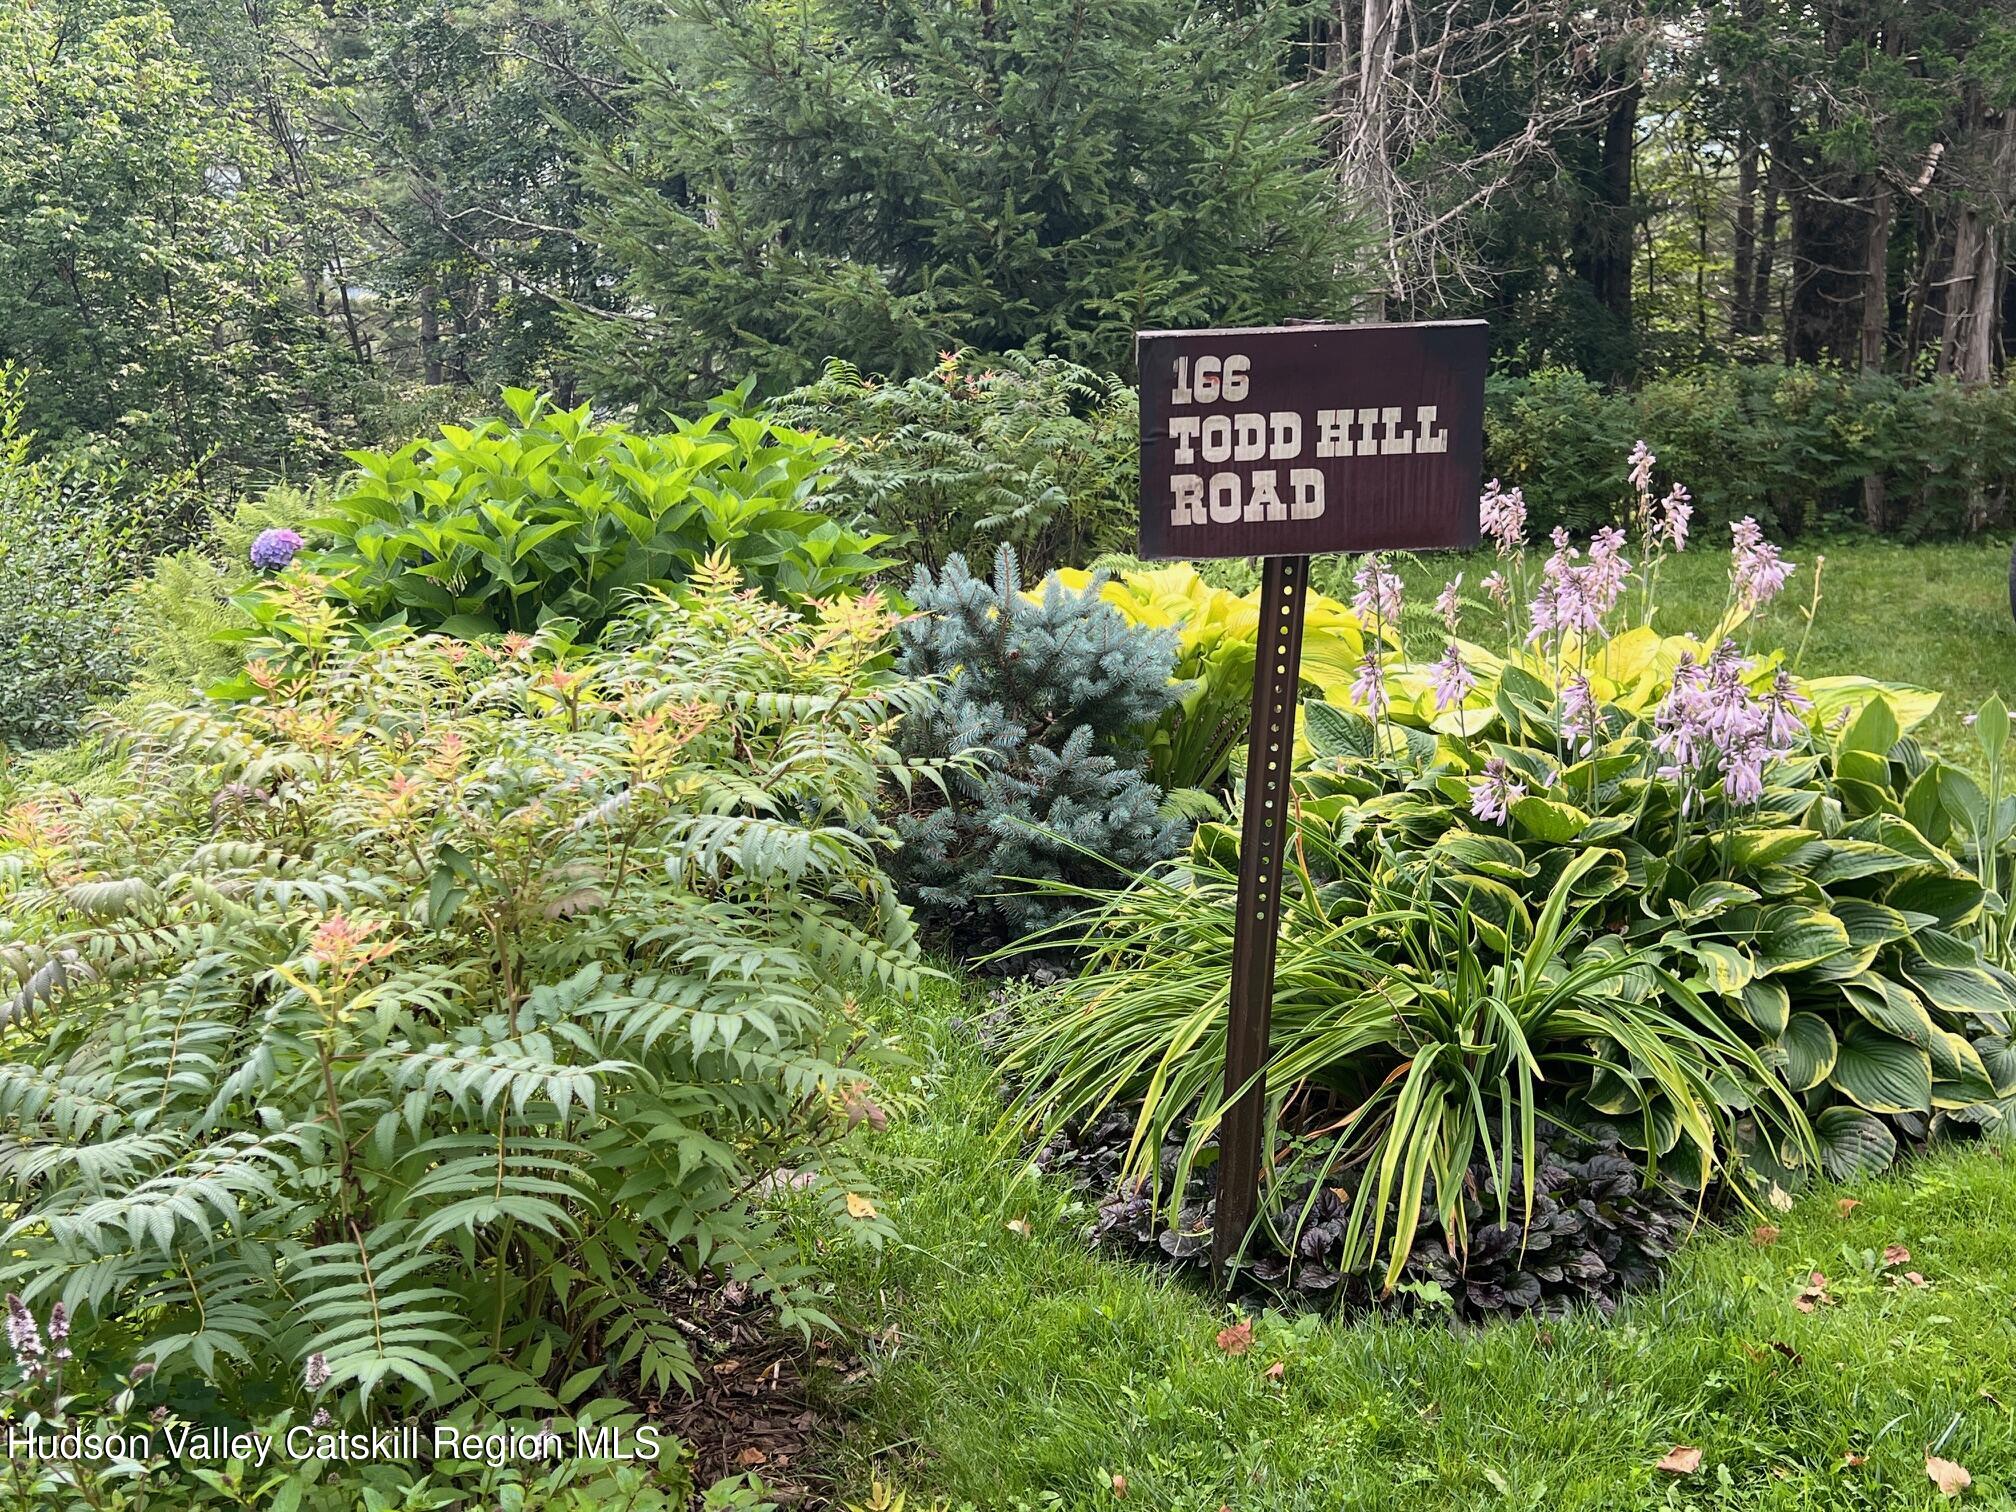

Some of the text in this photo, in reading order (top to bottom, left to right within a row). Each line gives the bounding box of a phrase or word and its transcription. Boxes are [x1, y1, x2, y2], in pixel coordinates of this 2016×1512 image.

[1171, 354, 1251, 405] 166
[1168, 405, 1448, 465] TODD HILL
[1170, 468, 1326, 526] ROAD
